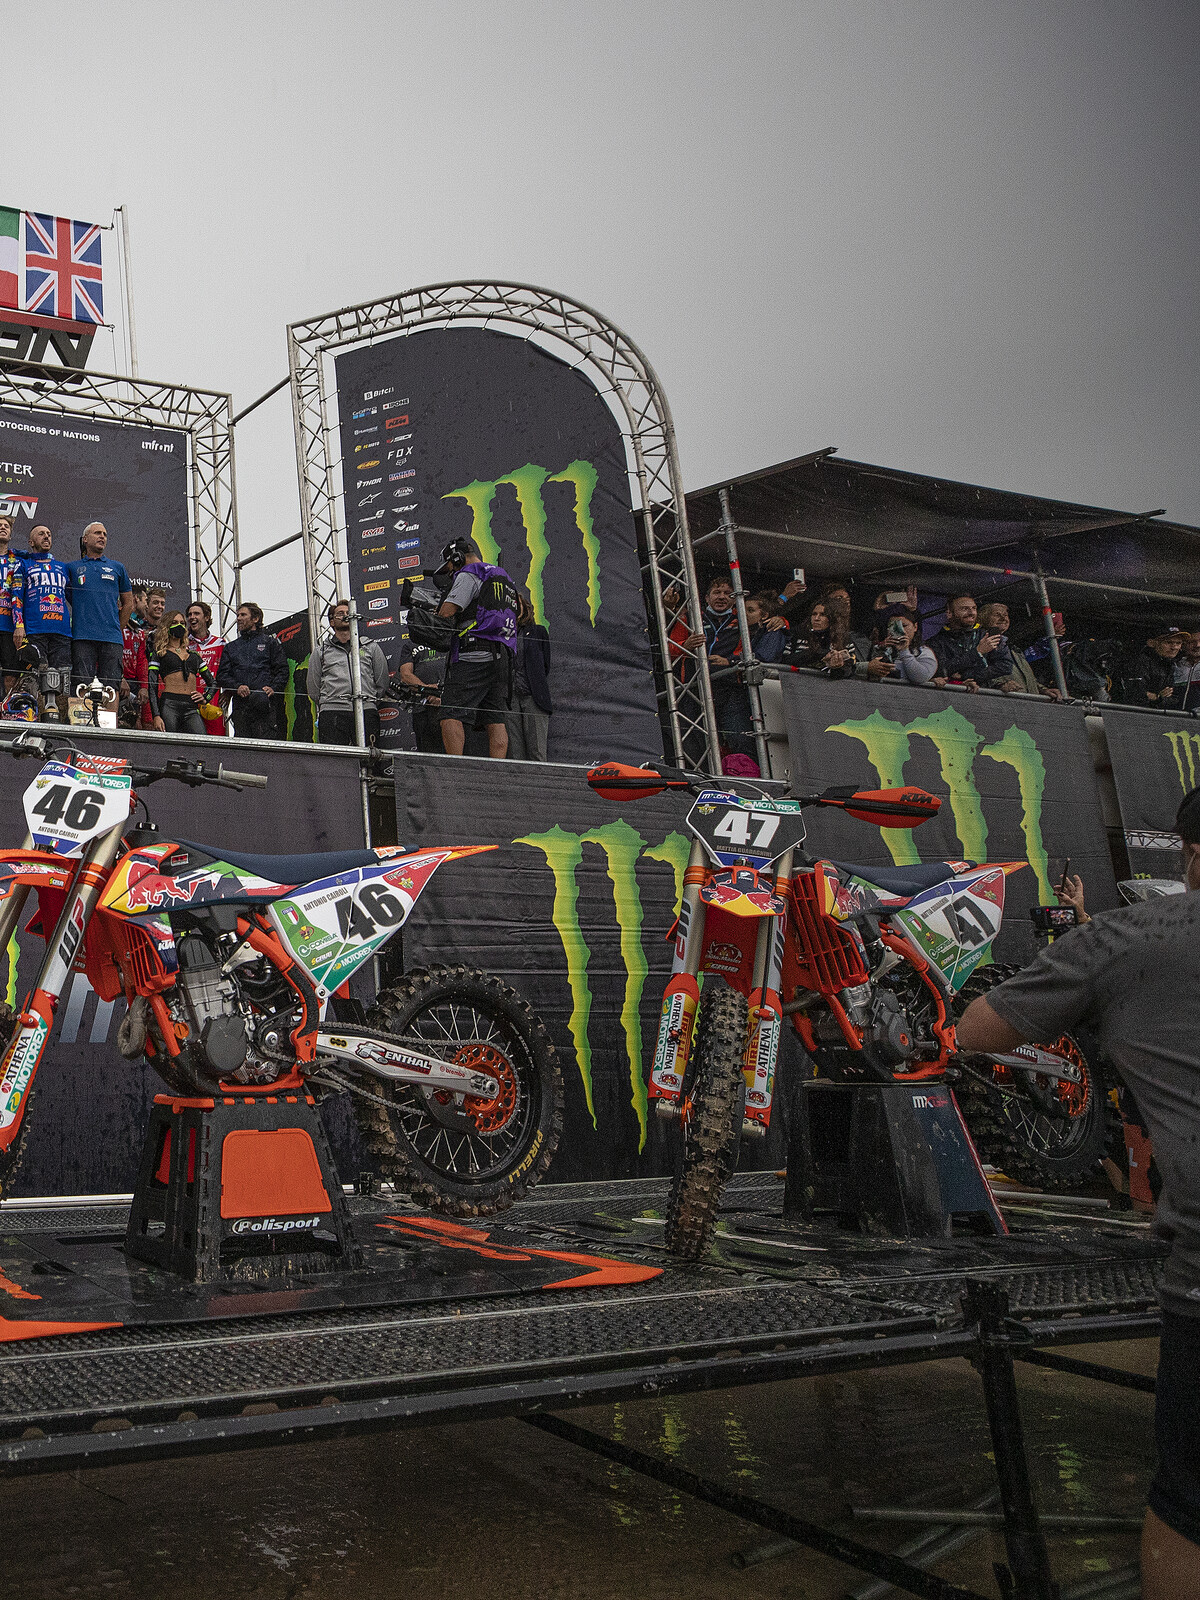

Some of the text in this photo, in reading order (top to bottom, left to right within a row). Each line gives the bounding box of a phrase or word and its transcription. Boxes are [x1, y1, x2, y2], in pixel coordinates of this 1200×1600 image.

[49, 428, 61, 436] OF
[62, 430, 100, 443] NATIONS
[387, 445, 414, 460] FOX
[362, 477, 382, 487] THOR
[368, 563, 389, 572] ATHENA
[129, 577, 172, 590] MONSTER
[40, 604, 52, 612] Red
[42, 613, 63, 621] KTM
[88, 776, 129, 789] MOTOREX
[592, 768, 620, 777] KTM
[32, 784, 106, 831] 46
[38, 826, 79, 840] ANTONIO CAIROLI
[713, 810, 780, 848] 47
[303, 886, 349, 912] ANTONIO CAIROLI
[334, 883, 406, 941] 46
[942, 895, 996, 947] 47
[157, 939, 176, 950] KTM
[341, 945, 373, 967] MOTOREX
[653, 1015, 669, 1071] MOTOREX
[757, 1027, 772, 1070] ATHENA
[769, 1017, 782, 1077] MOTOREX
[5, 1035, 32, 1084] ATHENA
[14, 1027, 48, 1092] MOTOREX
[508, 1129, 545, 1184] PIRELLI
[233, 1217, 321, 1235] Polisport
